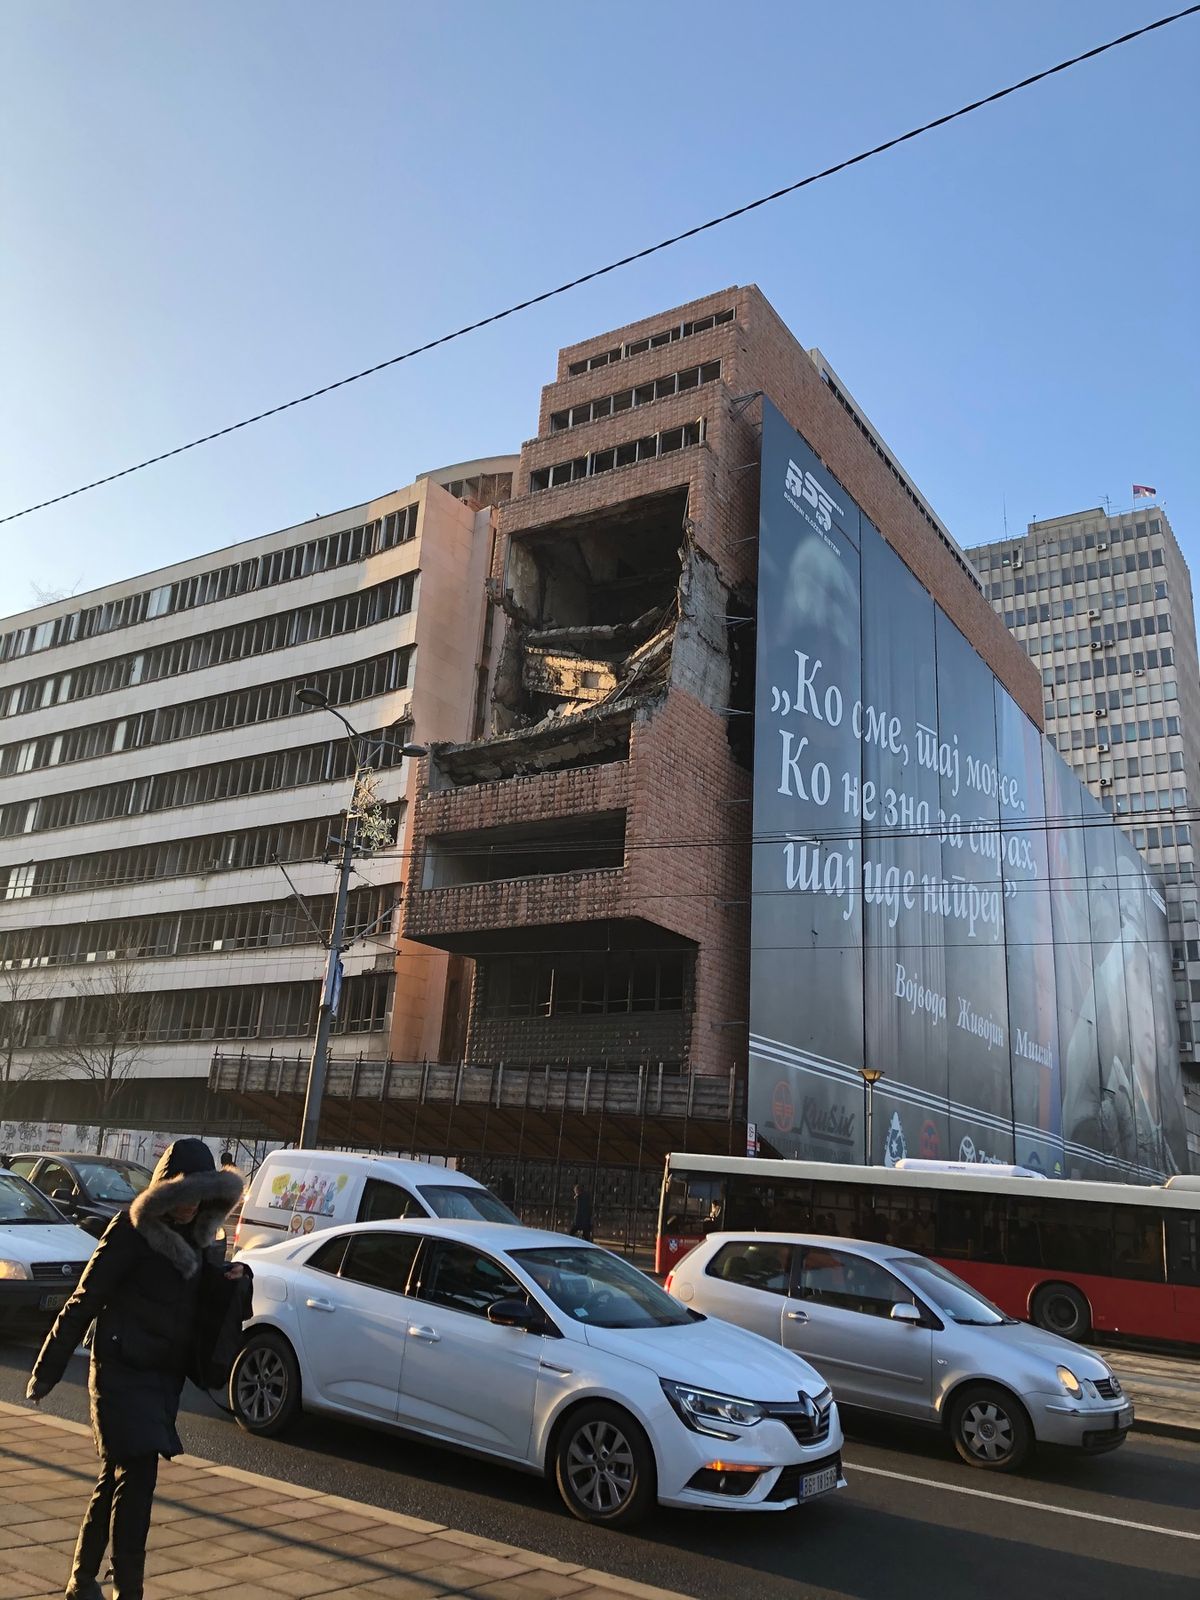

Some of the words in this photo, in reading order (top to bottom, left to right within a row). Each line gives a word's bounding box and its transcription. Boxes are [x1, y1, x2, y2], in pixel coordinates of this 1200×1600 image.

[777, 730, 831, 806] Ко
[842, 772, 877, 821] не
[884, 788, 932, 838] зна
[938, 808, 963, 849] за
[863, 861, 916, 928] иде
[894, 963, 947, 1026] Војвода
[956, 996, 1004, 1051] Живојин
